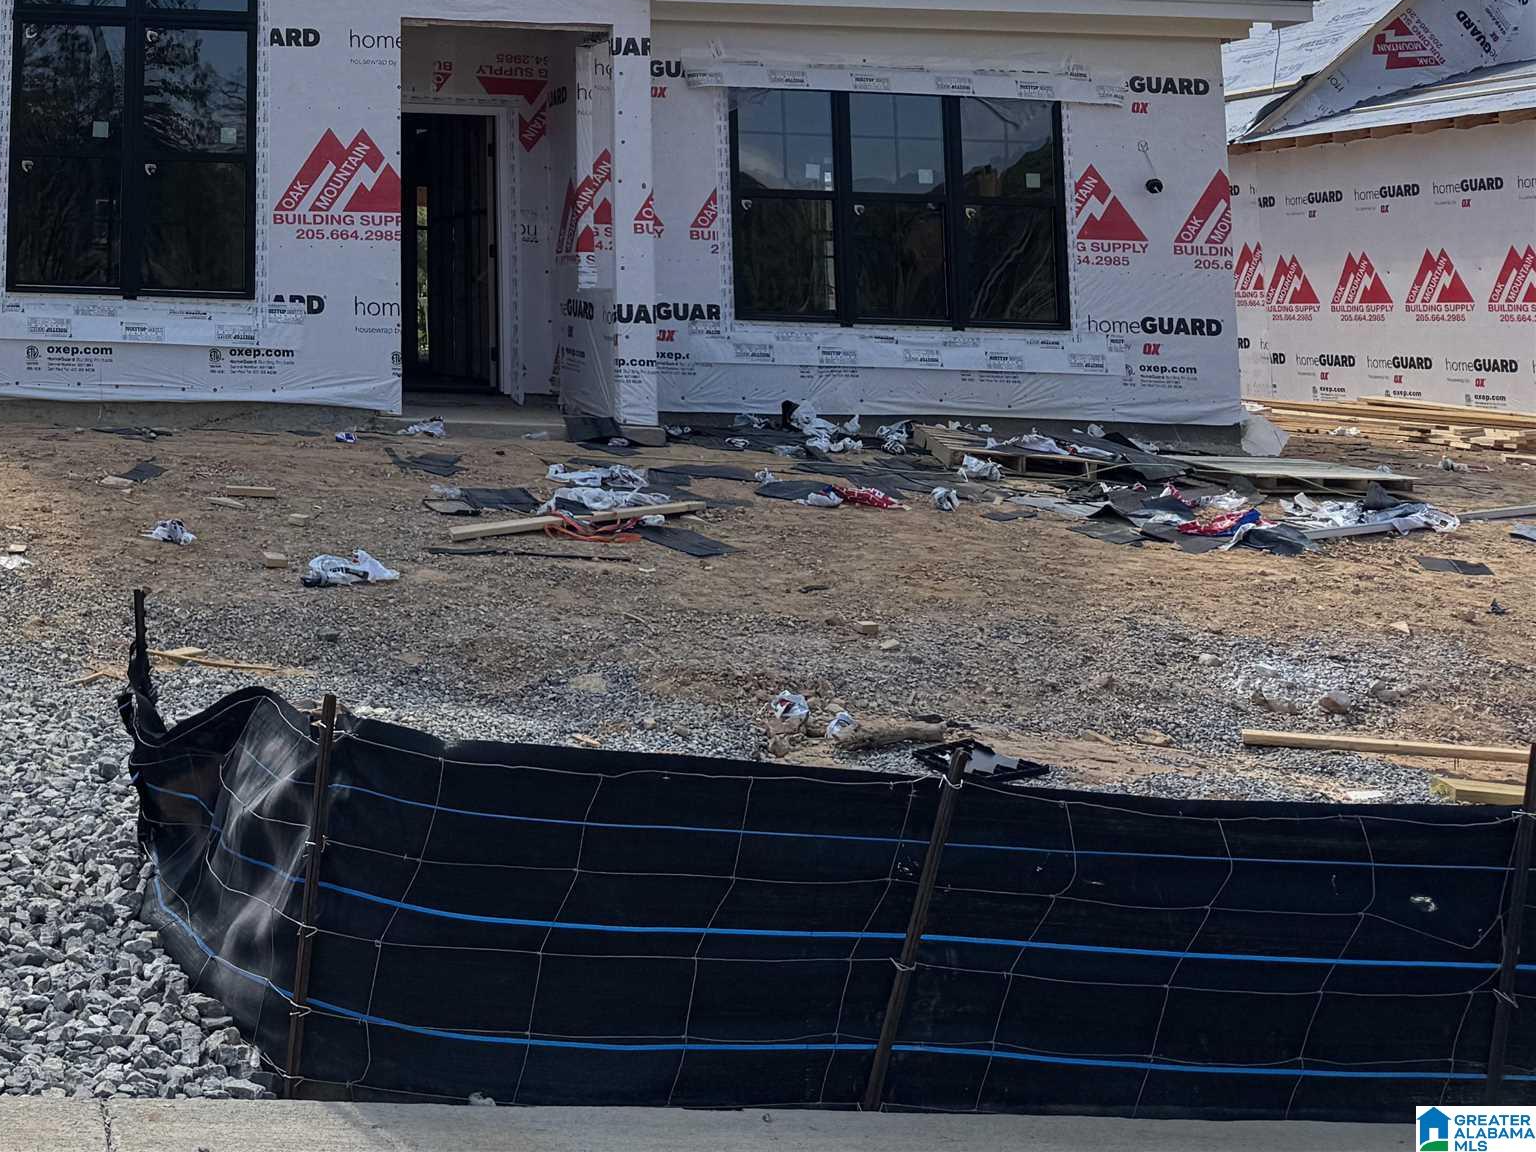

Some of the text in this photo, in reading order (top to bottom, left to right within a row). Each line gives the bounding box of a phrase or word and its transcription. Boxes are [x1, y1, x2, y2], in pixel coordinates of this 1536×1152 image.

[650, 60, 686, 78] GU
[1131, 102, 1149, 114] OX
[315, 142, 371, 210] MOUNTAIN
[1353, 183, 1420, 201] homeGUARD
[1432, 177, 1504, 194] homeGUARD
[282, 181, 309, 209] OAK
[1285, 190, 1343, 207] homeGUARD
[273, 213, 355, 226] BUILDING
[1180, 216, 1204, 241] OAK
[1090, 244, 1149, 254] SUPPLY
[1174, 245, 1233, 256] BUILDIN
[1194, 259, 1233, 270] 205.6
[1278, 263, 1297, 304] MOUNTAIN
[1347, 259, 1368, 303] MOUNTAIN
[1423, 256, 1448, 303] MOUNTAIN
[1507, 253, 1535, 302] MOUNTAIN
[1334, 285, 1345, 304] OAK
[1408, 283, 1420, 303] OAK
[1491, 282, 1504, 302] OAK
[354, 296, 400, 316] hom
[1405, 304, 1475, 312] BUILDING SUPPLY
[1488, 304, 1526, 312] BUILDING
[1087, 315, 1223, 336] homeGUARD
[1415, 314, 1466, 322] 205.664.2985
[47, 346, 113, 356] oxep.com
[229, 347, 295, 358] oxep.com
[1142, 343, 1161, 356] OX
[1139, 364, 1197, 374] oxep.com
[1295, 353, 1356, 368] homeGUARD
[1367, 355, 1433, 370] homeGUARD
[1445, 357, 1518, 373] homeGUARD
